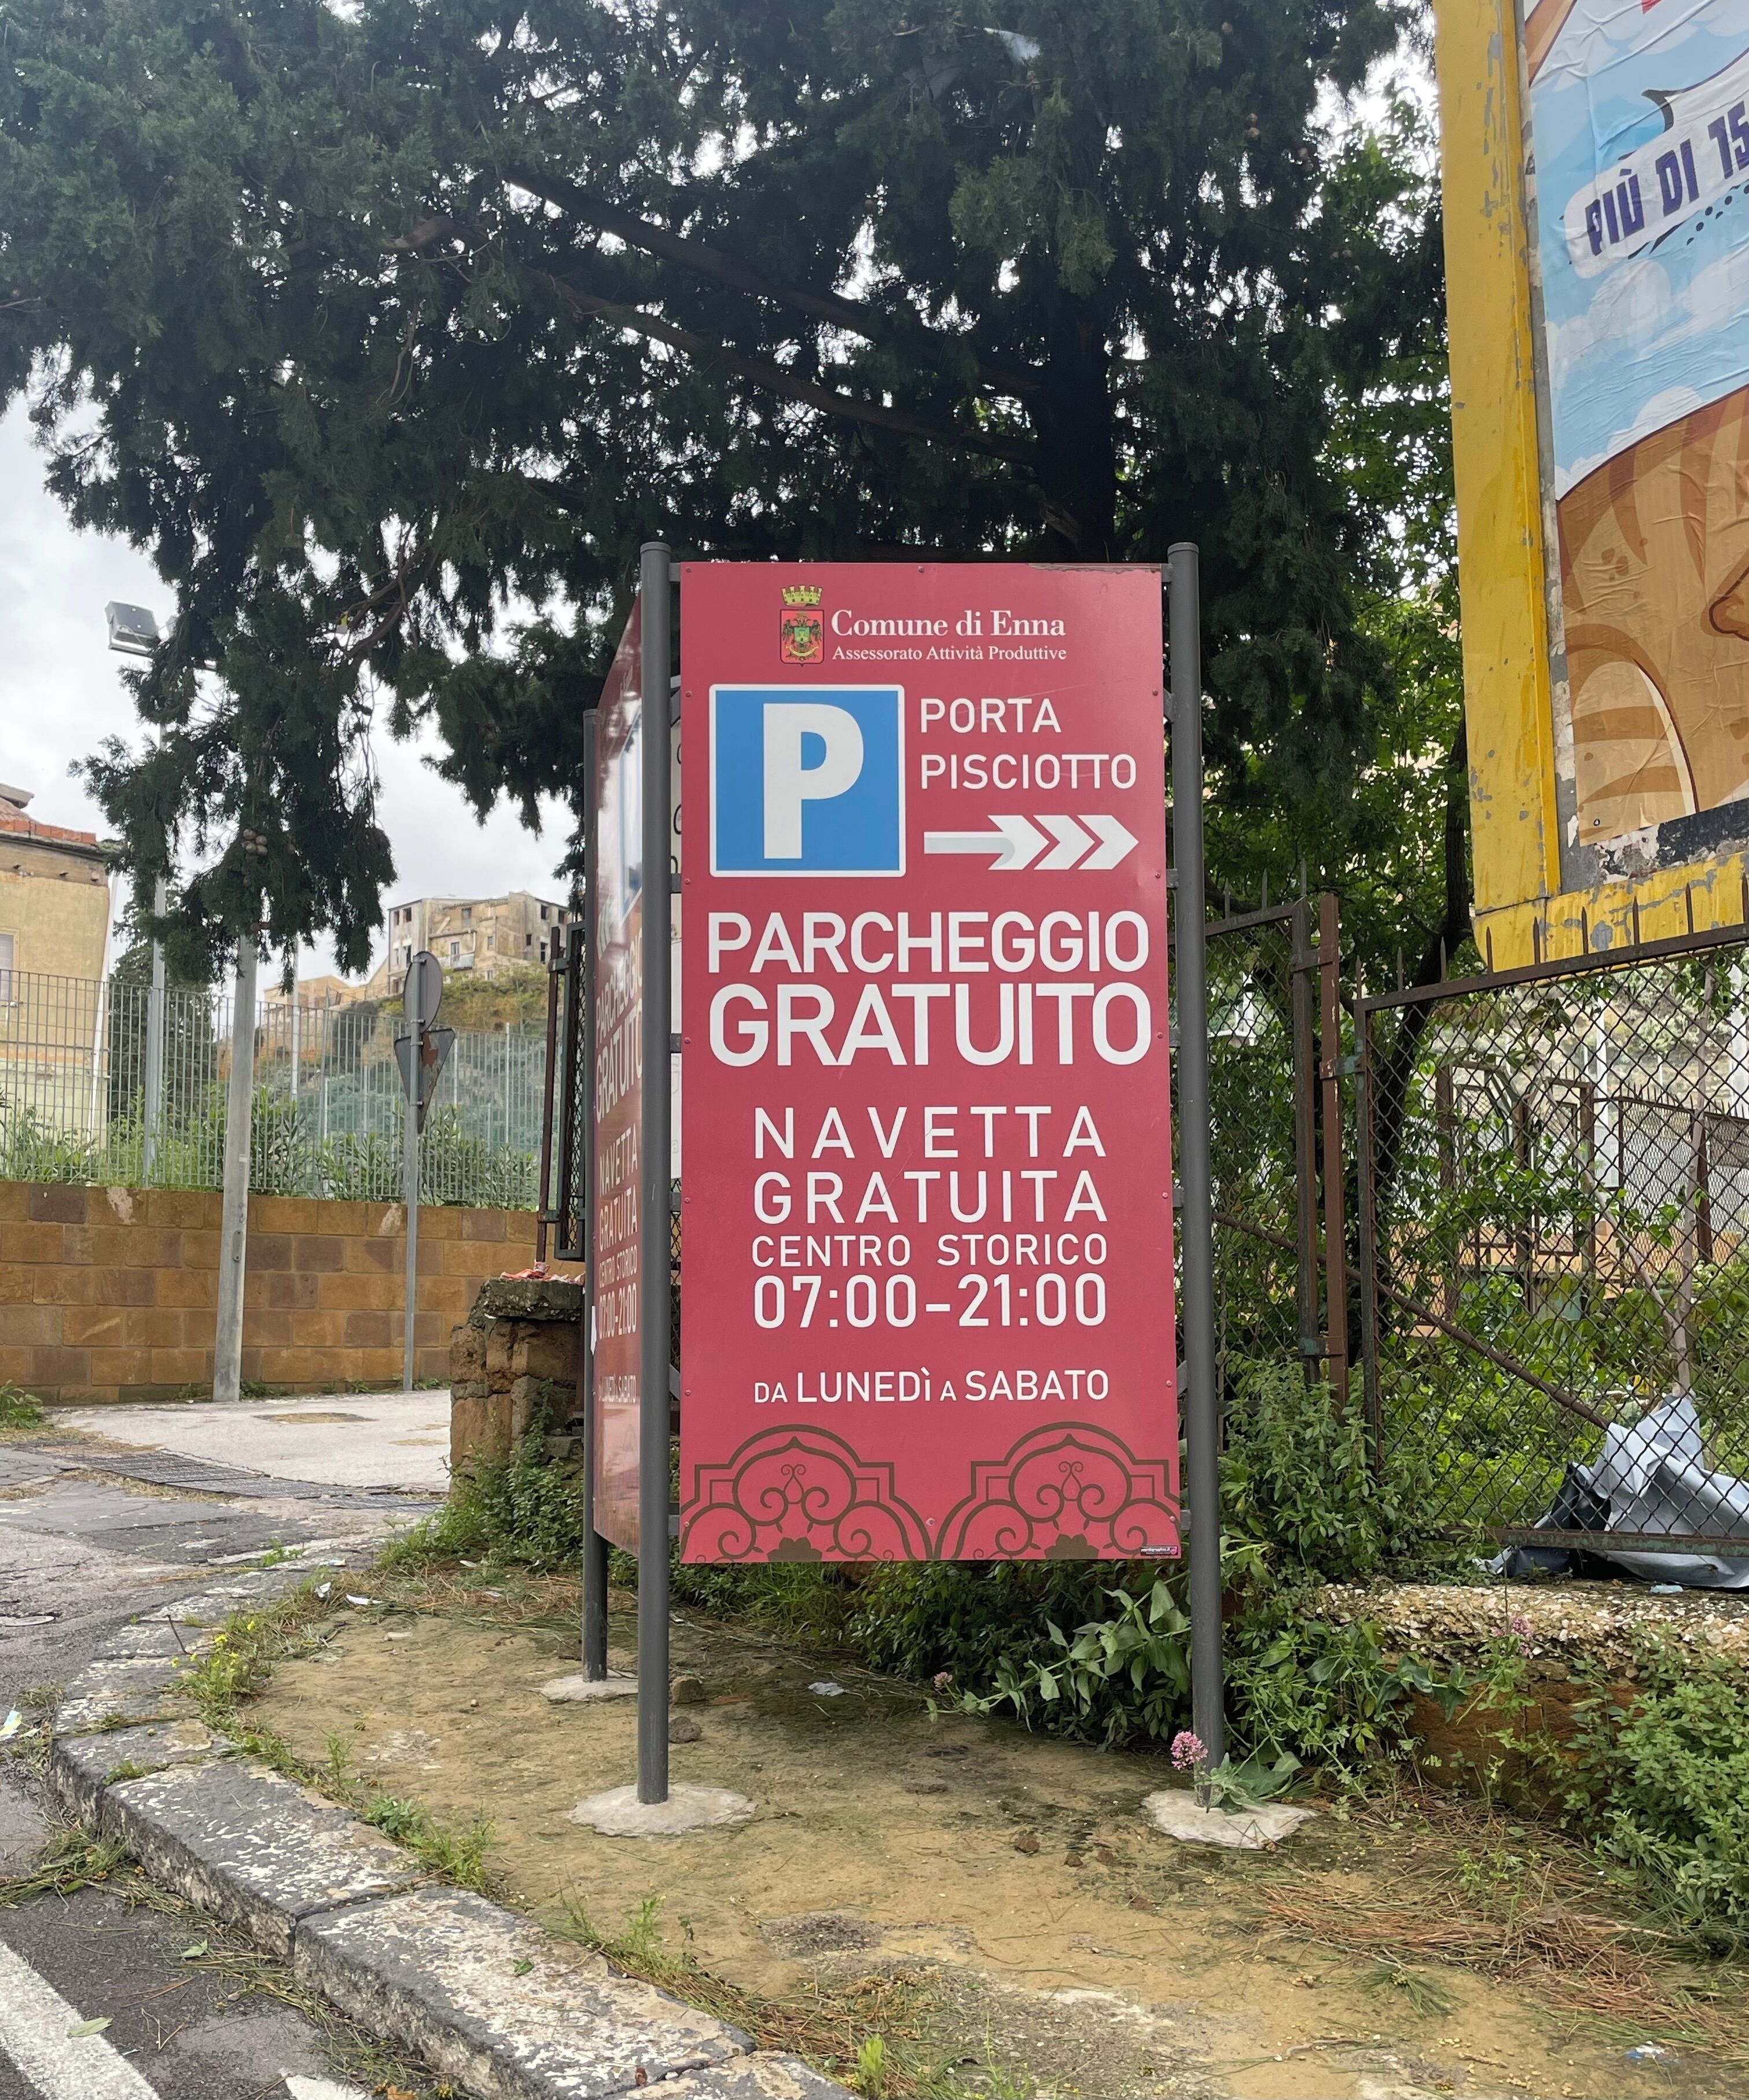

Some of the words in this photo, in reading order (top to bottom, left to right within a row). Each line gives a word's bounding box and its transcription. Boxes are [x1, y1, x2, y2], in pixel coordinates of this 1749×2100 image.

[1585, 168, 1645, 257] PIÙ
[1655, 138, 1700, 217] DI
[831, 609, 949, 637] Comune
[955, 609, 984, 637] di
[990, 610, 1067, 637] Enna
[832, 645, 923, 661] Assessorato
[926, 645, 984, 660] Attività
[988, 645, 1067, 661] Produttive
[920, 698, 1062, 733] PORTA
[763, 703, 864, 859] P
[921, 753, 1137, 790] PISCIOTTO
[708, 910, 1149, 973] PARCHEGGIO
[710, 981, 1152, 1067] GRATUITO
[755, 1105, 1107, 1159] NAVETTA
[600, 1123, 637, 1198] NAVETTA
[600, 1185, 637, 1252] GRATUITA
[754, 1170, 1108, 1224] GRATUITA
[752, 1234, 910, 1267] CENTRO
[937, 1233, 1107, 1266] STORICO
[754, 1382, 788, 1403] DA
[939, 1381, 957, 1402] A
[965, 1369, 1108, 1402] SABATO
